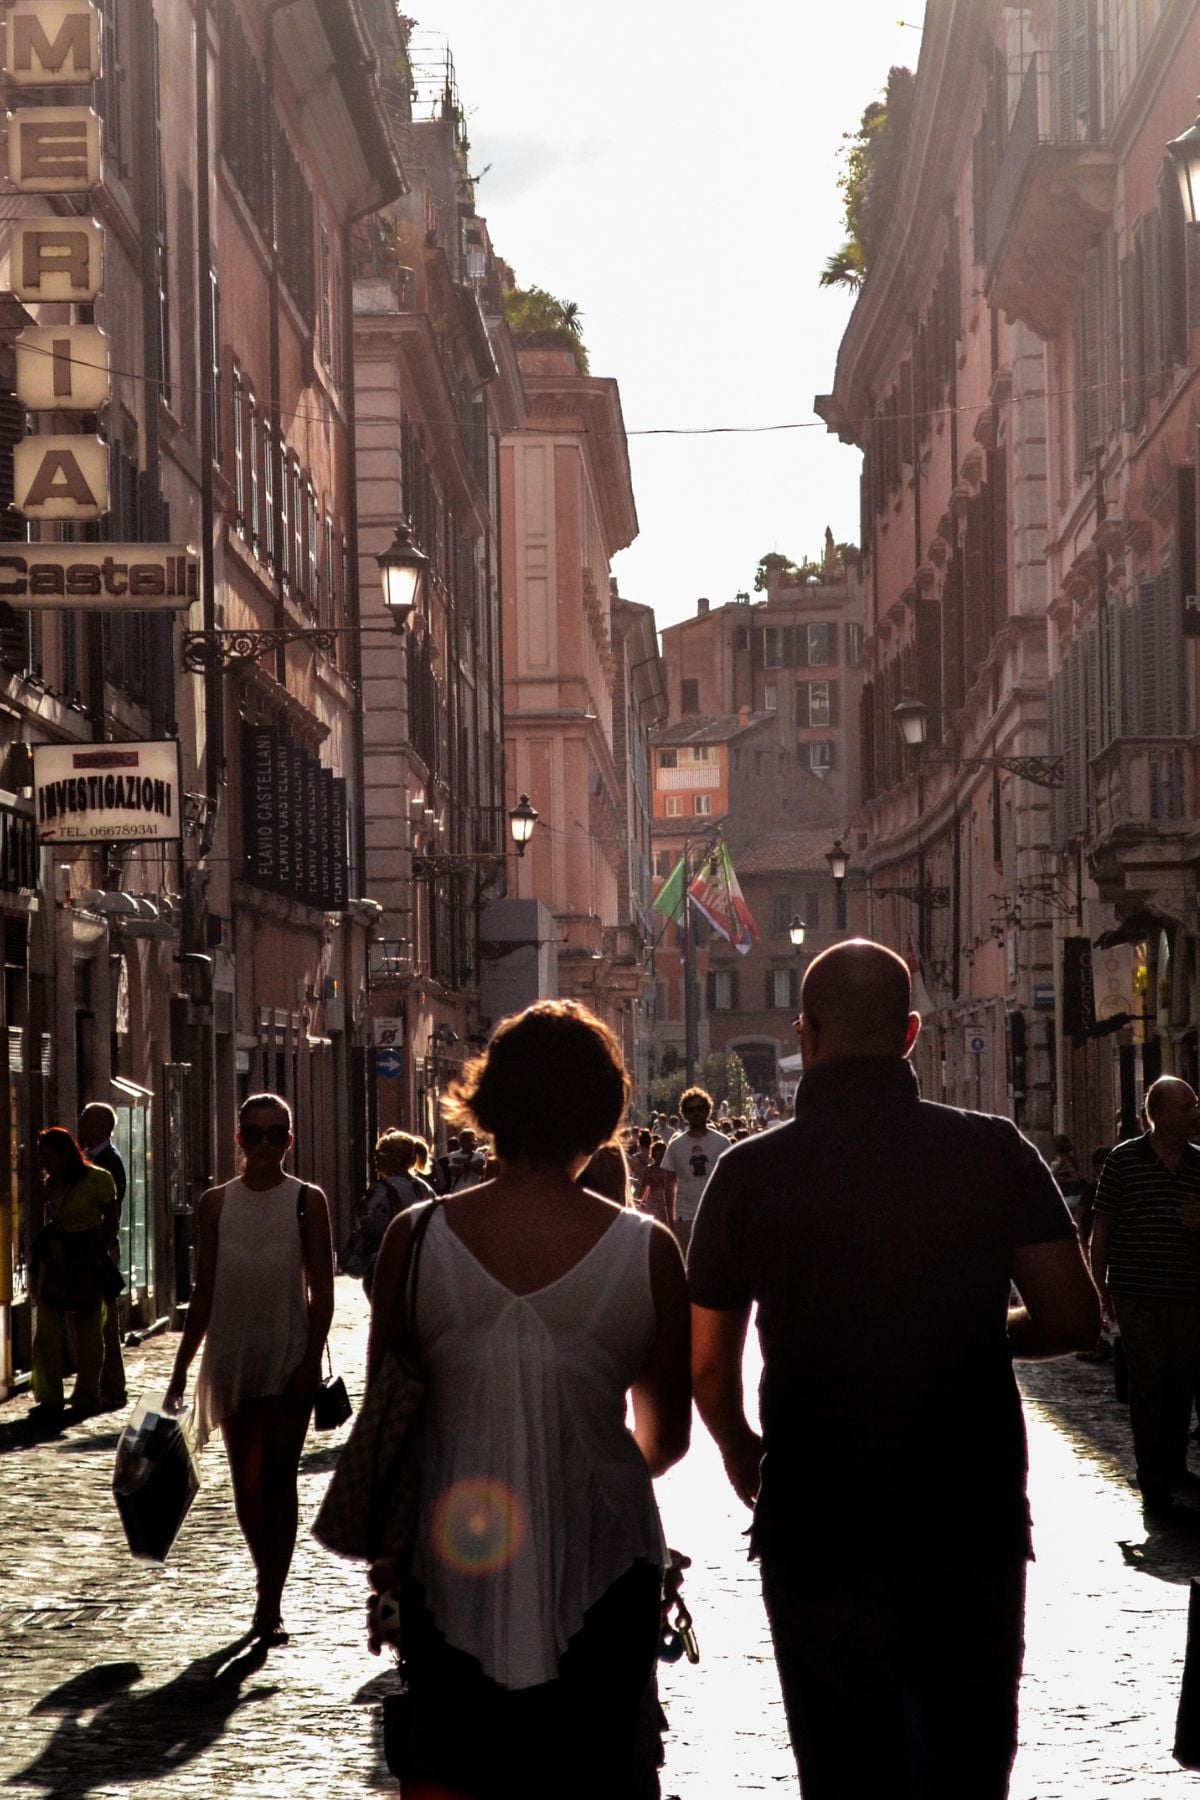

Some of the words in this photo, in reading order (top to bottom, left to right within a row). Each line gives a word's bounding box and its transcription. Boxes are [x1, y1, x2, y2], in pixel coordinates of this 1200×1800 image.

[13, 13, 97, 506] MERIA
[0, 556, 197, 597] Castelli
[38, 774, 172, 823] INVESTIGAZIONI
[255, 735, 271, 821] CASTELLANI
[58, 826, 87, 837] TEL.
[89, 825, 158, 837] 066789341
[257, 826, 272, 875] FLAVIO
